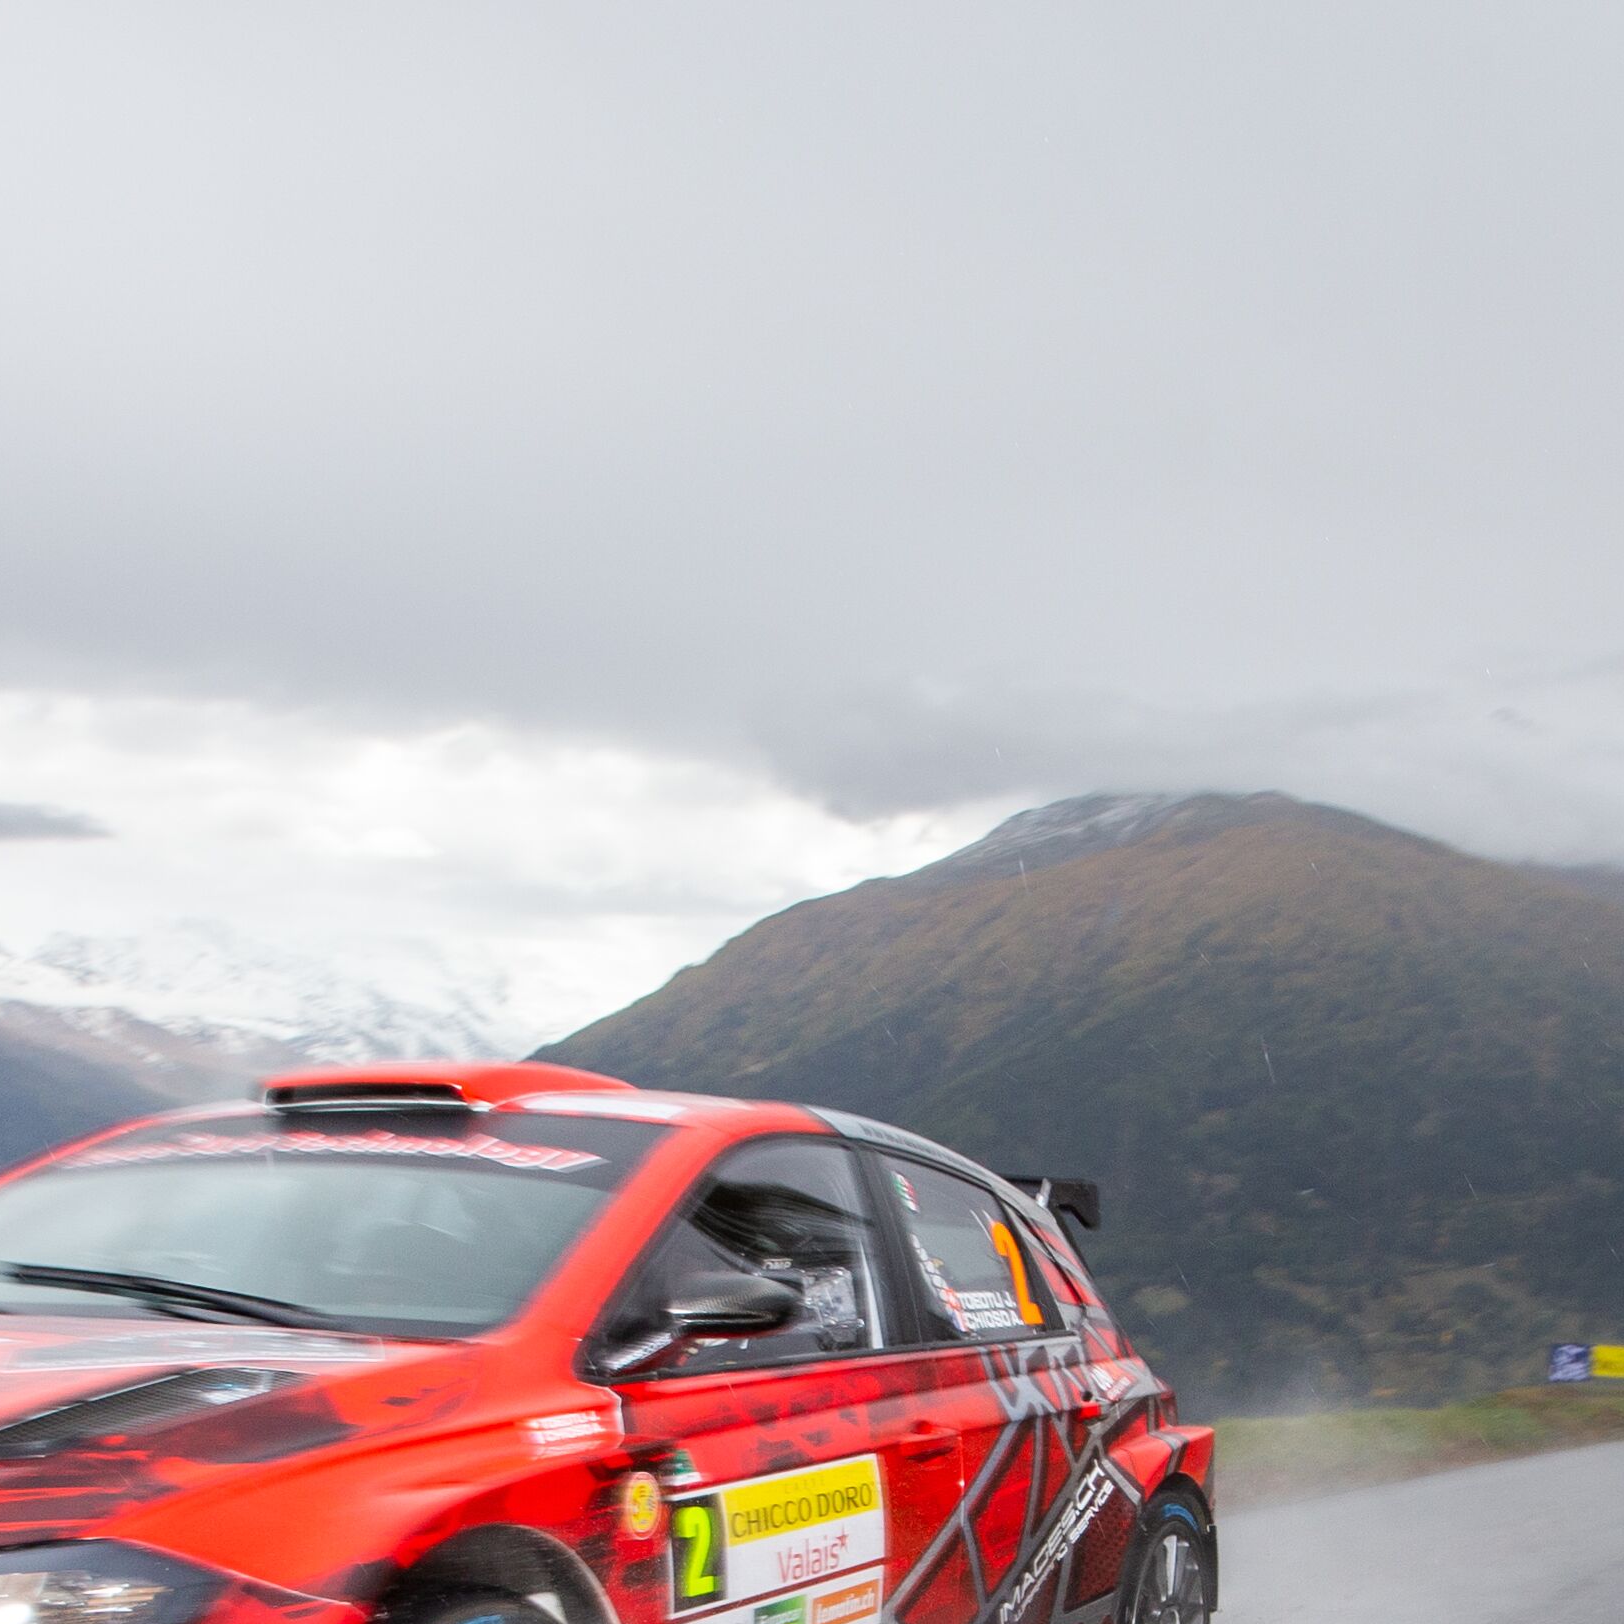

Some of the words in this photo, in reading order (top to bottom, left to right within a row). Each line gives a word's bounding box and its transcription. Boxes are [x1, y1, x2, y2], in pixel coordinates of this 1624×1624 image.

[731, 1497, 812, 1538] CHICCO
[816, 1482, 874, 1518] D'ORO
[1069, 1479, 1115, 1544] SERVICE
[676, 1506, 716, 1597] 2
[777, 1535, 840, 1583] Valais
